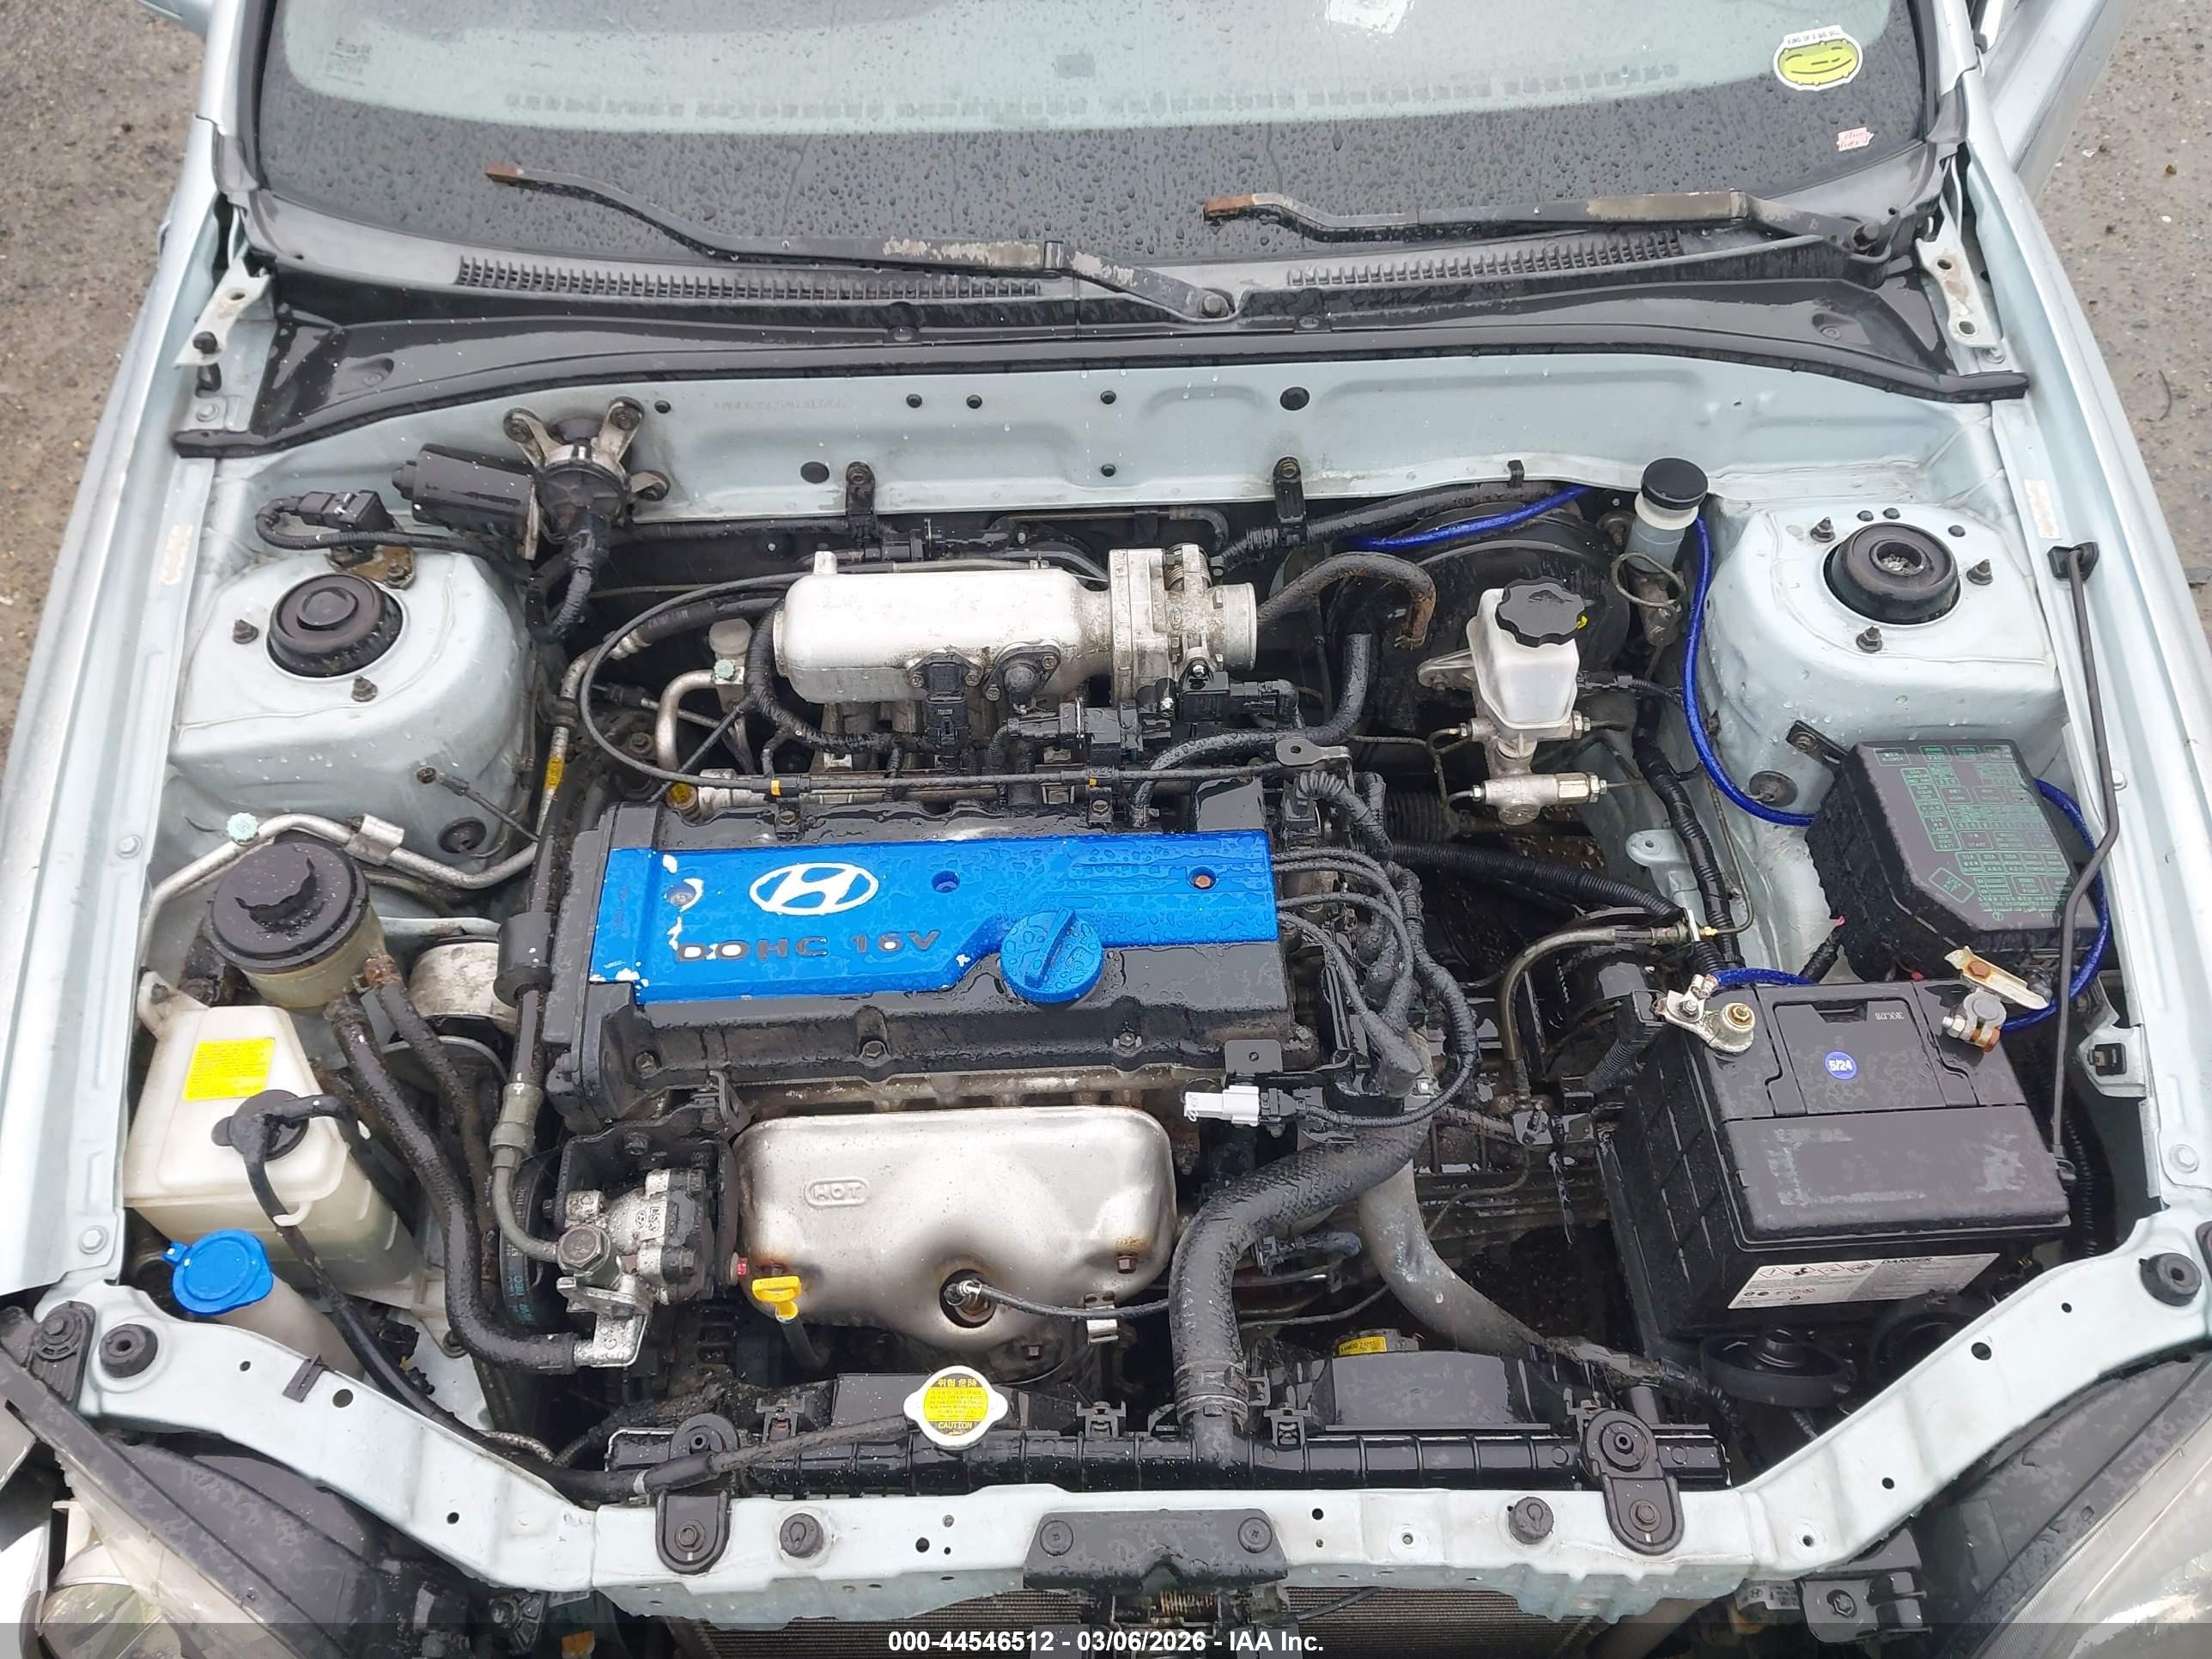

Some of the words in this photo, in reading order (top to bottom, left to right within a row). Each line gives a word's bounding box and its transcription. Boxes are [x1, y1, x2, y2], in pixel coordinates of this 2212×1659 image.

[677, 935, 828, 962] DOHC
[852, 929, 941, 953] 16V
[812, 1187, 861, 1201] HOT
[1881, 1256, 1933, 1265] DANGER
[938, 1421, 973, 1430] CAUTION
